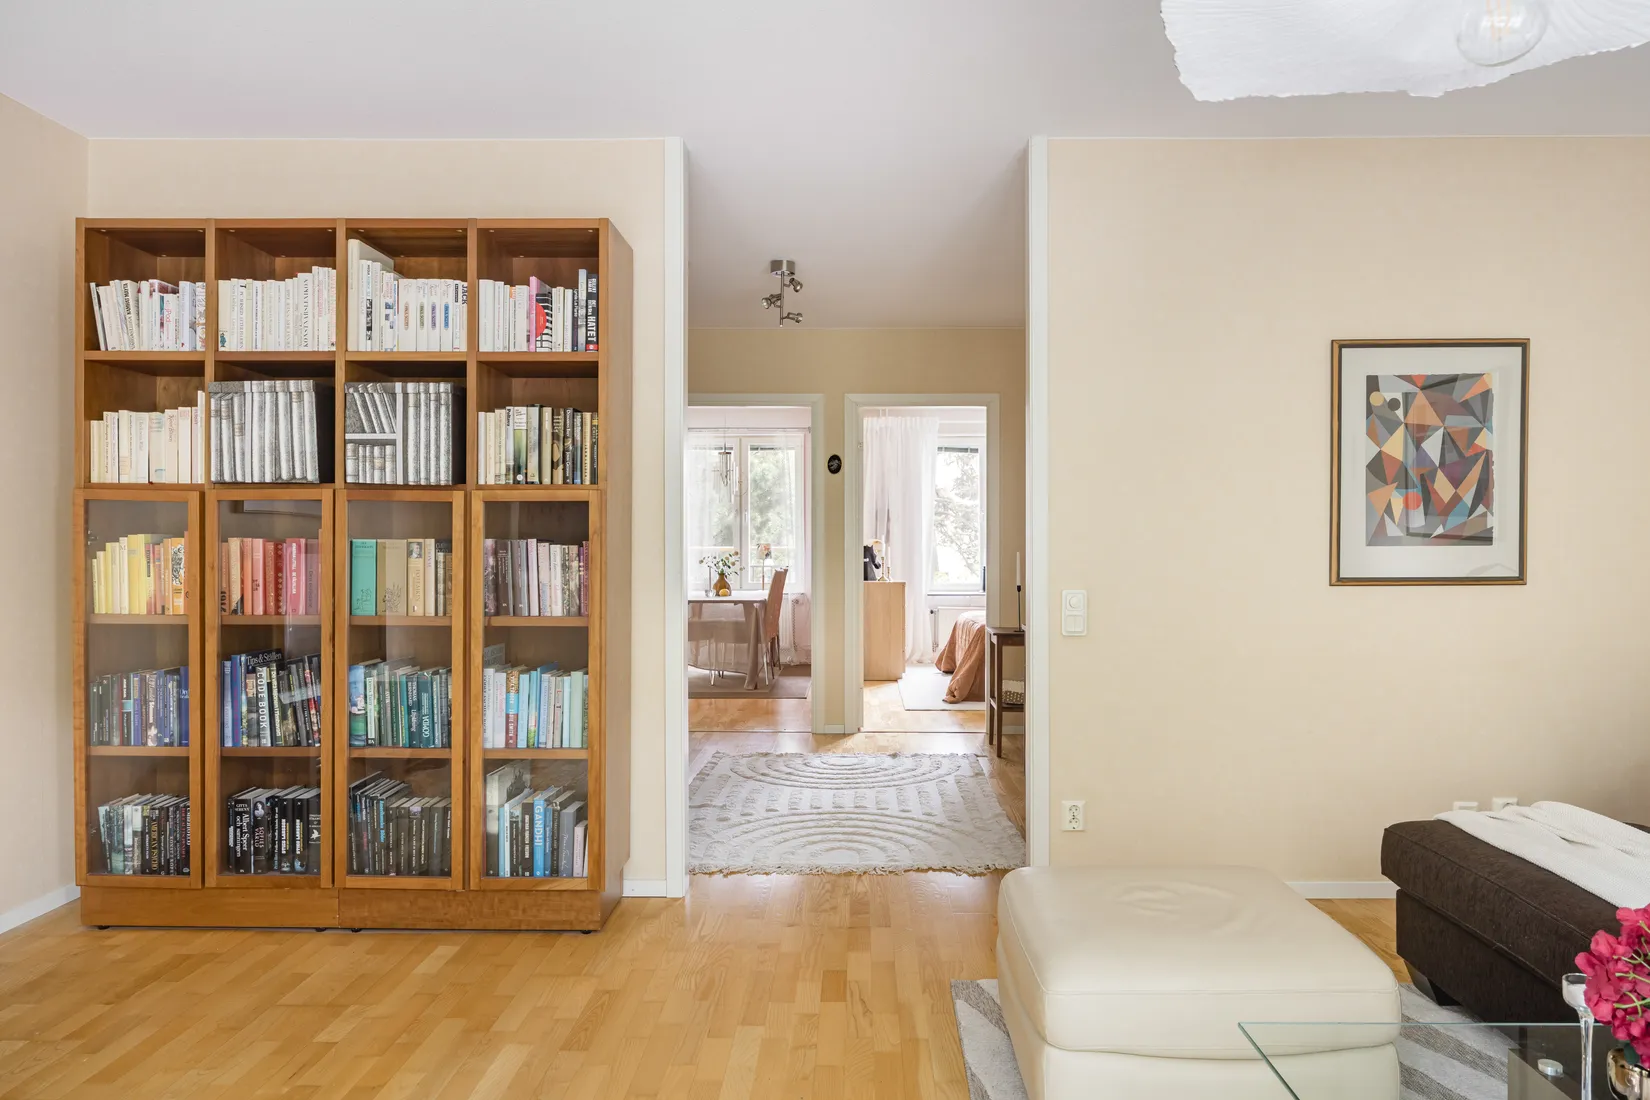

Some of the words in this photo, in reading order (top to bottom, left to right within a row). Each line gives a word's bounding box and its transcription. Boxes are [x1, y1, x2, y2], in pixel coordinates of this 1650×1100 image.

[587, 316, 597, 342] HATET
[247, 656, 258, 666] Tips
[257, 672, 267, 699] CODE
[258, 701, 268, 729] BOOK
[150, 821, 158, 848] AMERICAN
[242, 813, 250, 833] Albert
[535, 805, 543, 846] GANDHI
[241, 833, 249, 851] Speer
[150, 849, 158, 871] PSYCHO
